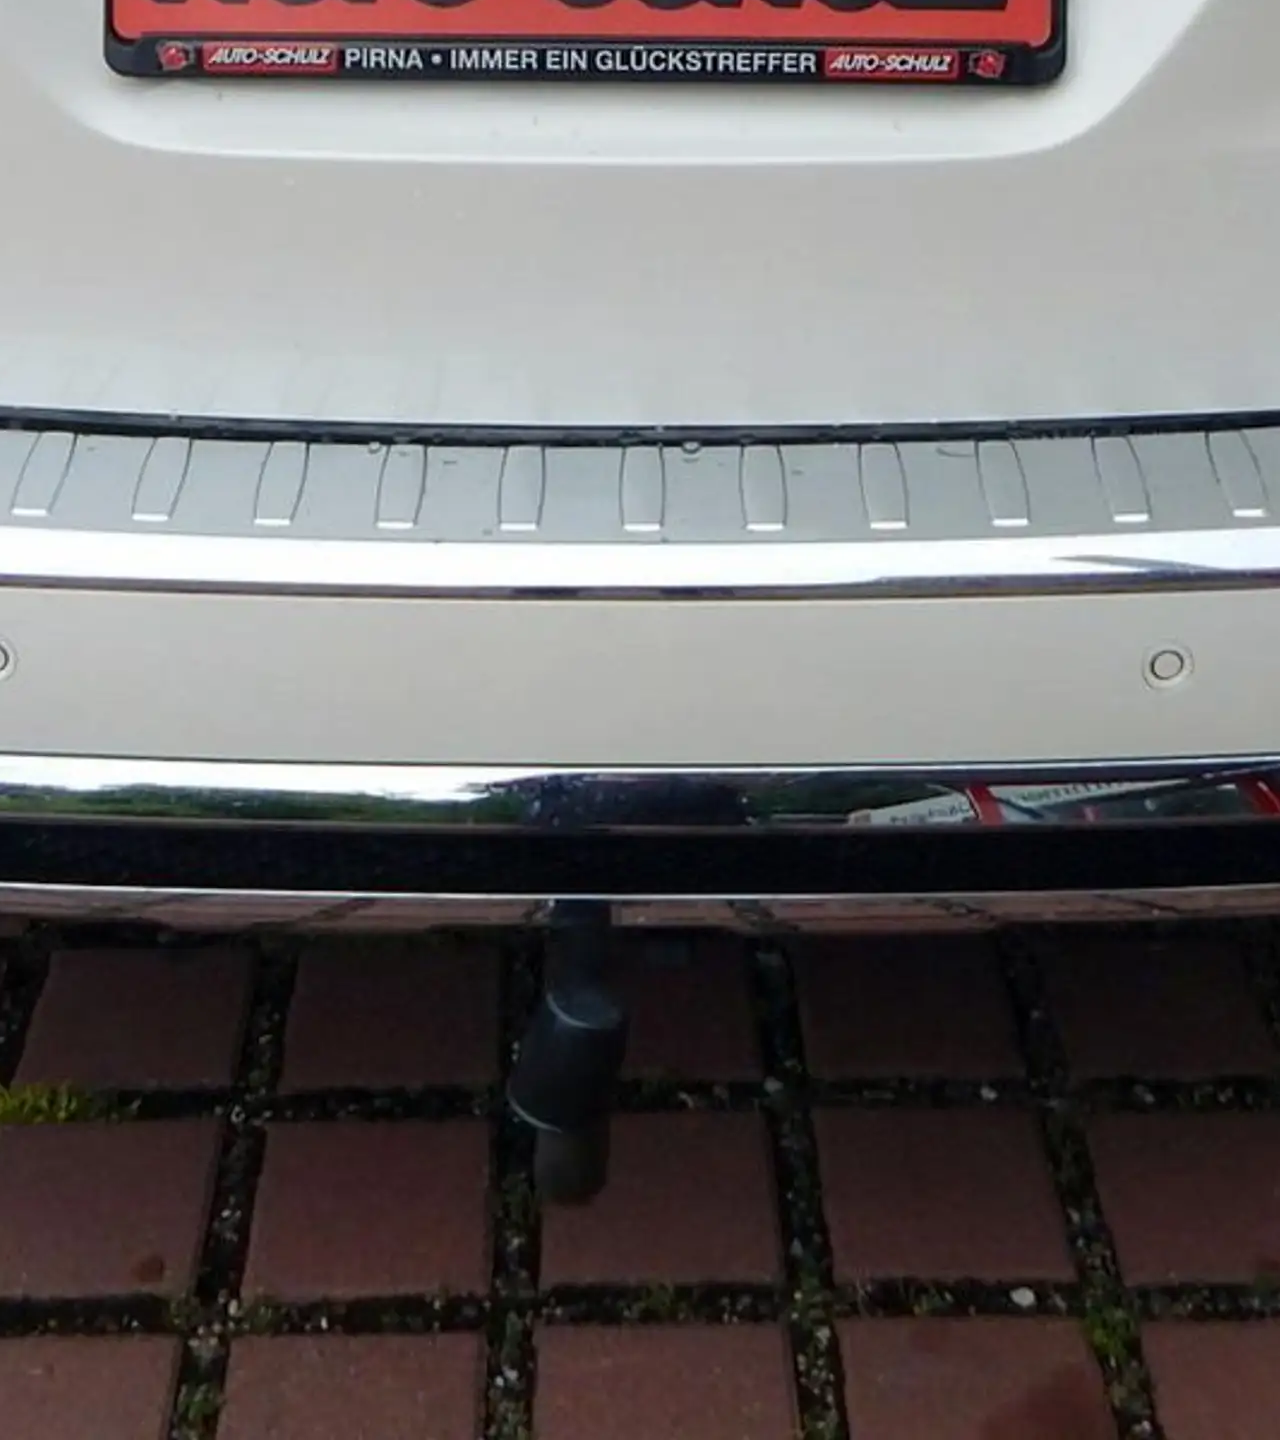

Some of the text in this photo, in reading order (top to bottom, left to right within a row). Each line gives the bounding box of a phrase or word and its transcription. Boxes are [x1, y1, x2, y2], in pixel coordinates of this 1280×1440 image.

[208, 45, 953, 74] AUTO-SCHULZ PIRNA IMMER EIN GLÜCKSTREFFER AUTO-SCHULZ
